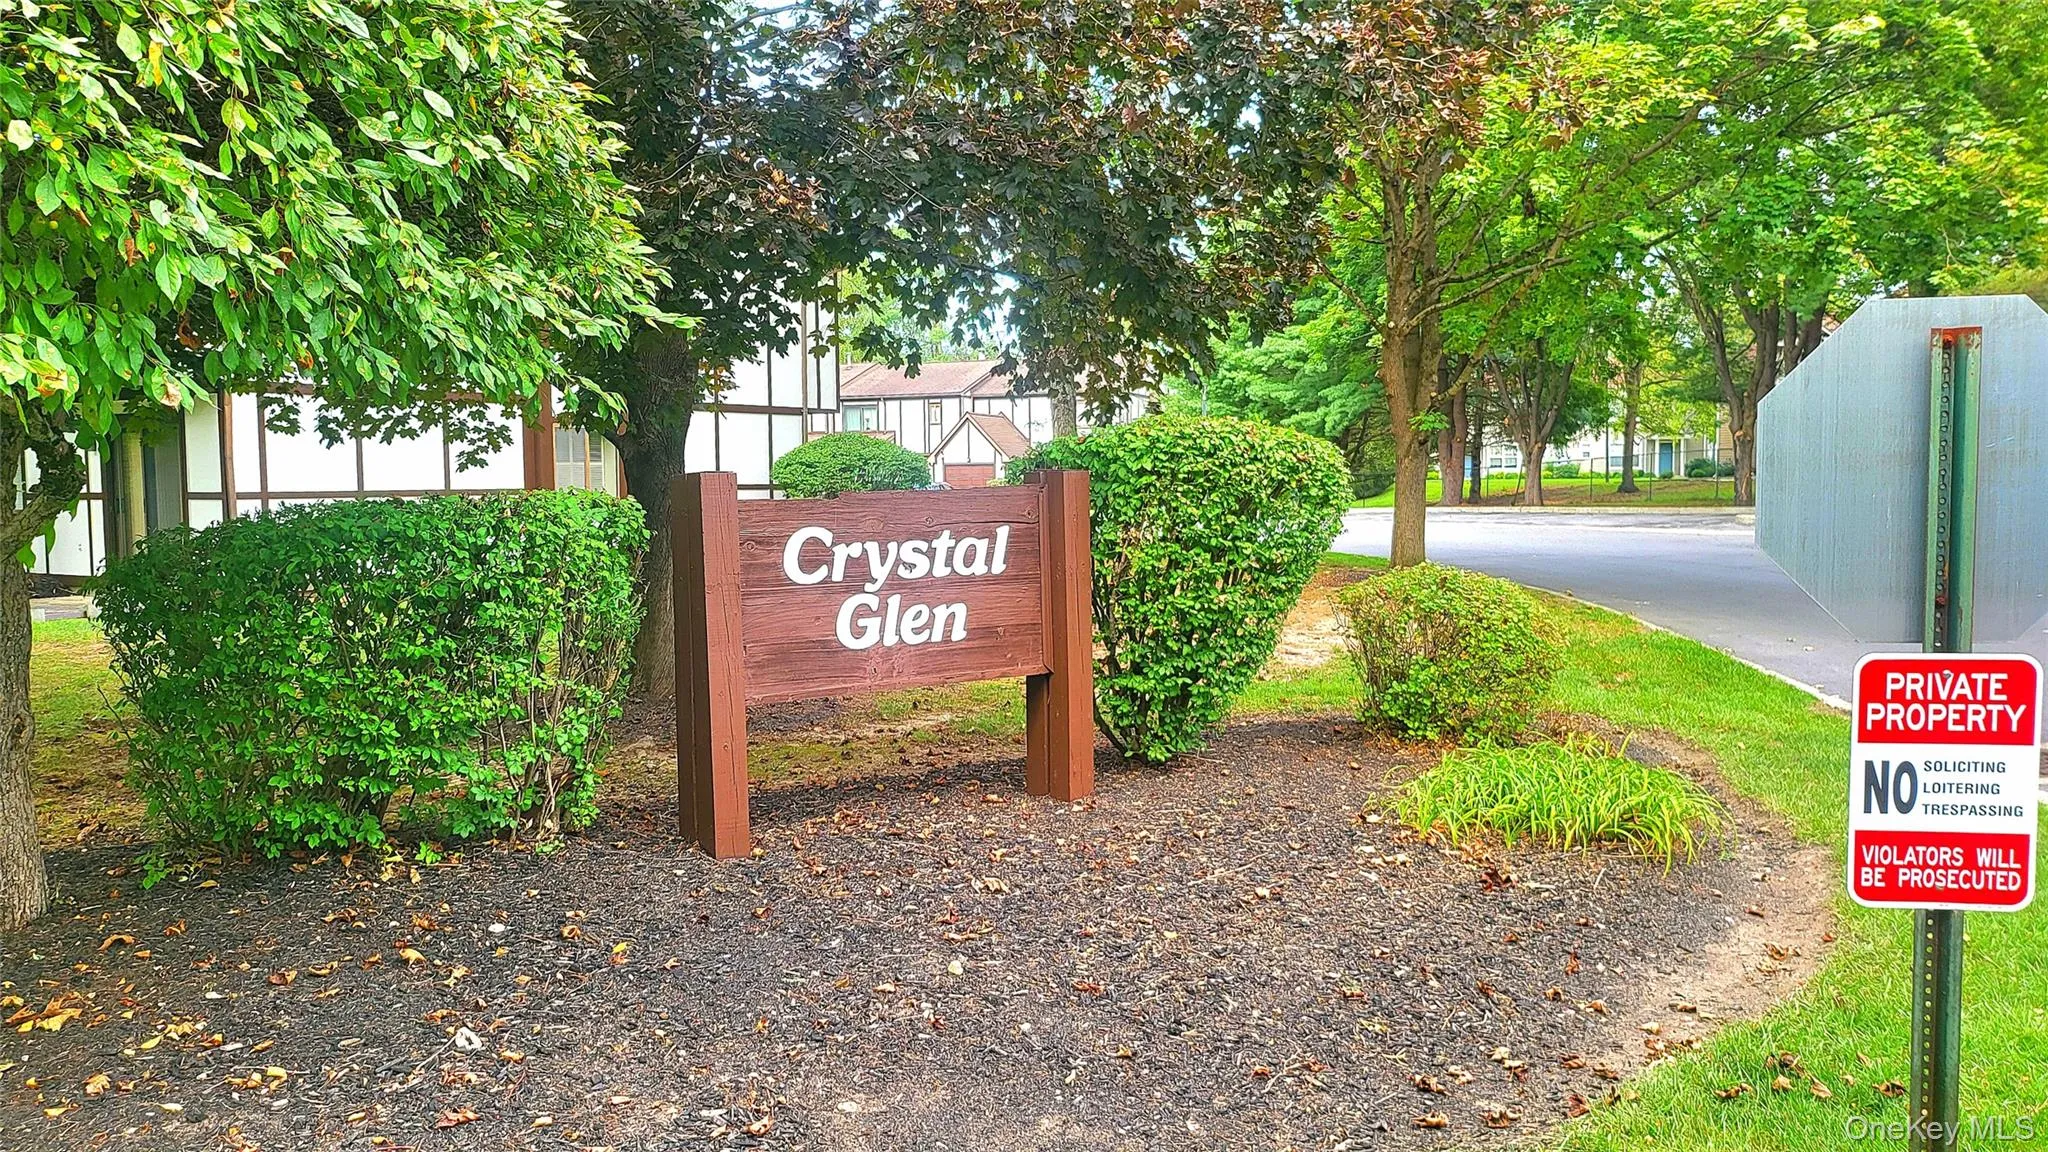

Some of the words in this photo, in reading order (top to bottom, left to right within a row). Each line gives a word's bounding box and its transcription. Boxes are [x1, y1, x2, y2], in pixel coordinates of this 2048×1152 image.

[783, 524, 1010, 593] Crystal
[835, 593, 968, 650] Glen
[1885, 672, 2008, 701] PRIVATE
[1866, 703, 2027, 732] PROPERTY
[1923, 760, 2006, 773] SOLICITING
[1863, 760, 1918, 814] NO
[1923, 782, 2000, 795] LOITERING
[1922, 804, 2023, 817] TRESPASSING
[1862, 845, 1964, 867] VIOLATORS
[1976, 848, 2022, 868] WILL
[1860, 867, 1885, 887] BE
[1898, 868, 2021, 891] PROSECUTED
